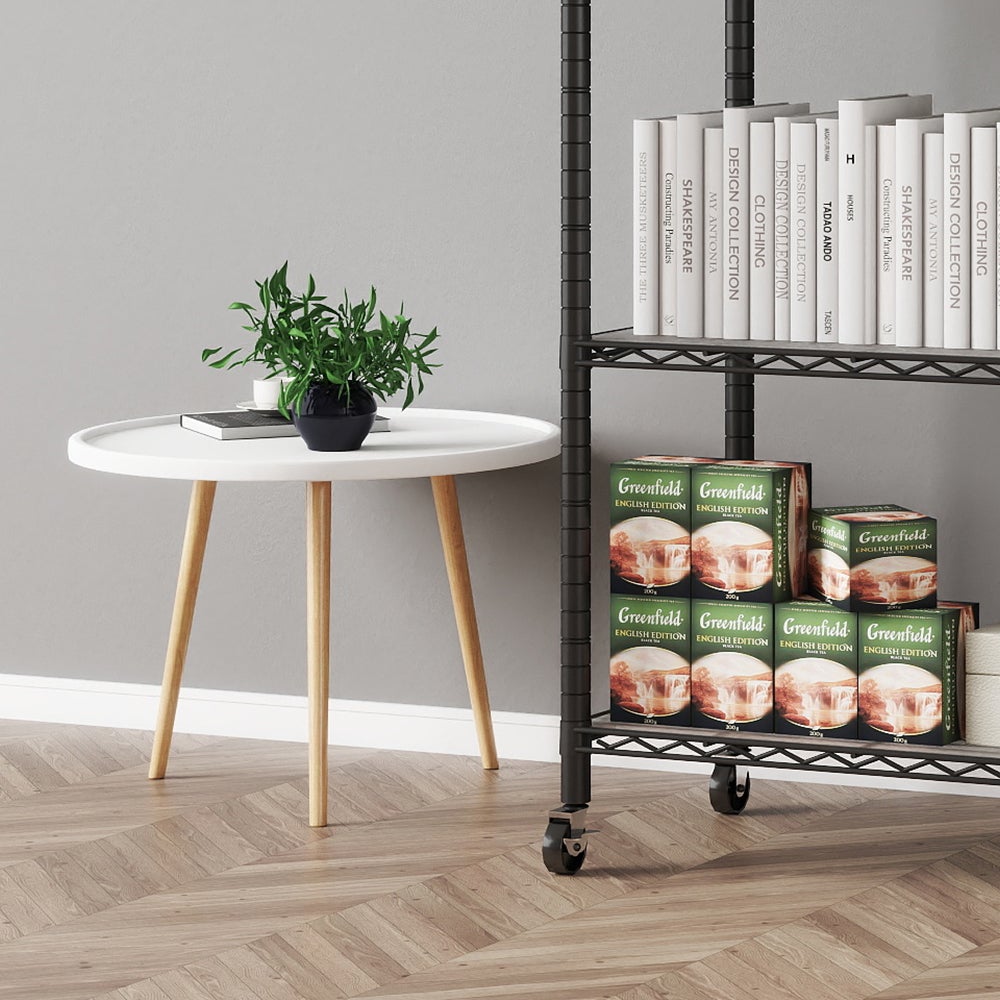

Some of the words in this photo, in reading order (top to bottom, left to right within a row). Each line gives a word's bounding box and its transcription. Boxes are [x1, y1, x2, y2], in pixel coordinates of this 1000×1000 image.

[639, 151, 647, 232] MUSKETEERS
[728, 147, 739, 202] DESIGN
[775, 160, 789, 211] DESIGN
[797, 164, 806, 215] DESIGN
[949, 153, 961, 208] DESIGN
[664, 172, 674, 226] Constructing
[709, 192, 717, 209] MY
[881, 178, 893, 233] Constructing
[929, 198, 937, 217] MY
[682, 179, 693, 274] SHAKESPEARE
[754, 194, 766, 268] CLOTHING
[823, 201, 832, 234] TADAO
[901, 185, 912, 281] SHAKESPEARE
[639, 236, 647, 275] THREE
[665, 228, 674, 264] Paradies
[709, 217, 717, 274] ANTONIA
[728, 206, 739, 301] COLLECTION
[823, 236, 832, 262] ANDO
[883, 236, 892, 272] Paradies
[929, 222, 937, 282] ANTONIA
[976, 201, 987, 276] CLOTHING
[775, 215, 789, 300] COLLECTION
[797, 219, 806, 303] COLLECTION
[949, 212, 961, 310] COLLECTION
[639, 279, 647, 303] THE
[615, 499, 649, 509] ENGLISH
[651, 501, 686, 511] EDITION
[618, 477, 681, 497] Greenfield
[700, 481, 764, 501] Greenfield
[696, 504, 731, 514] ENGLISH
[733, 505, 768, 515] EDITION
[855, 545, 894, 553] ENGLISH
[895, 543, 933, 552] EDITION
[859, 528, 927, 544] Greenfield
[618, 606, 681, 627] Greenfield
[700, 611, 764, 632] Greenfield
[783, 617, 848, 638] Greenfield
[867, 623, 932, 644] Greenfield
[615, 629, 649, 639] ENGLISH
[651, 630, 686, 641] EDITION
[696, 634, 731, 644] ENGLISH
[732, 636, 768, 646] EDITION
[780, 640, 815, 649] ENGLISH
[817, 641, 853, 652] EDITION
[863, 646, 899, 655] ENGLISH
[901, 647, 938, 658] EDITION
